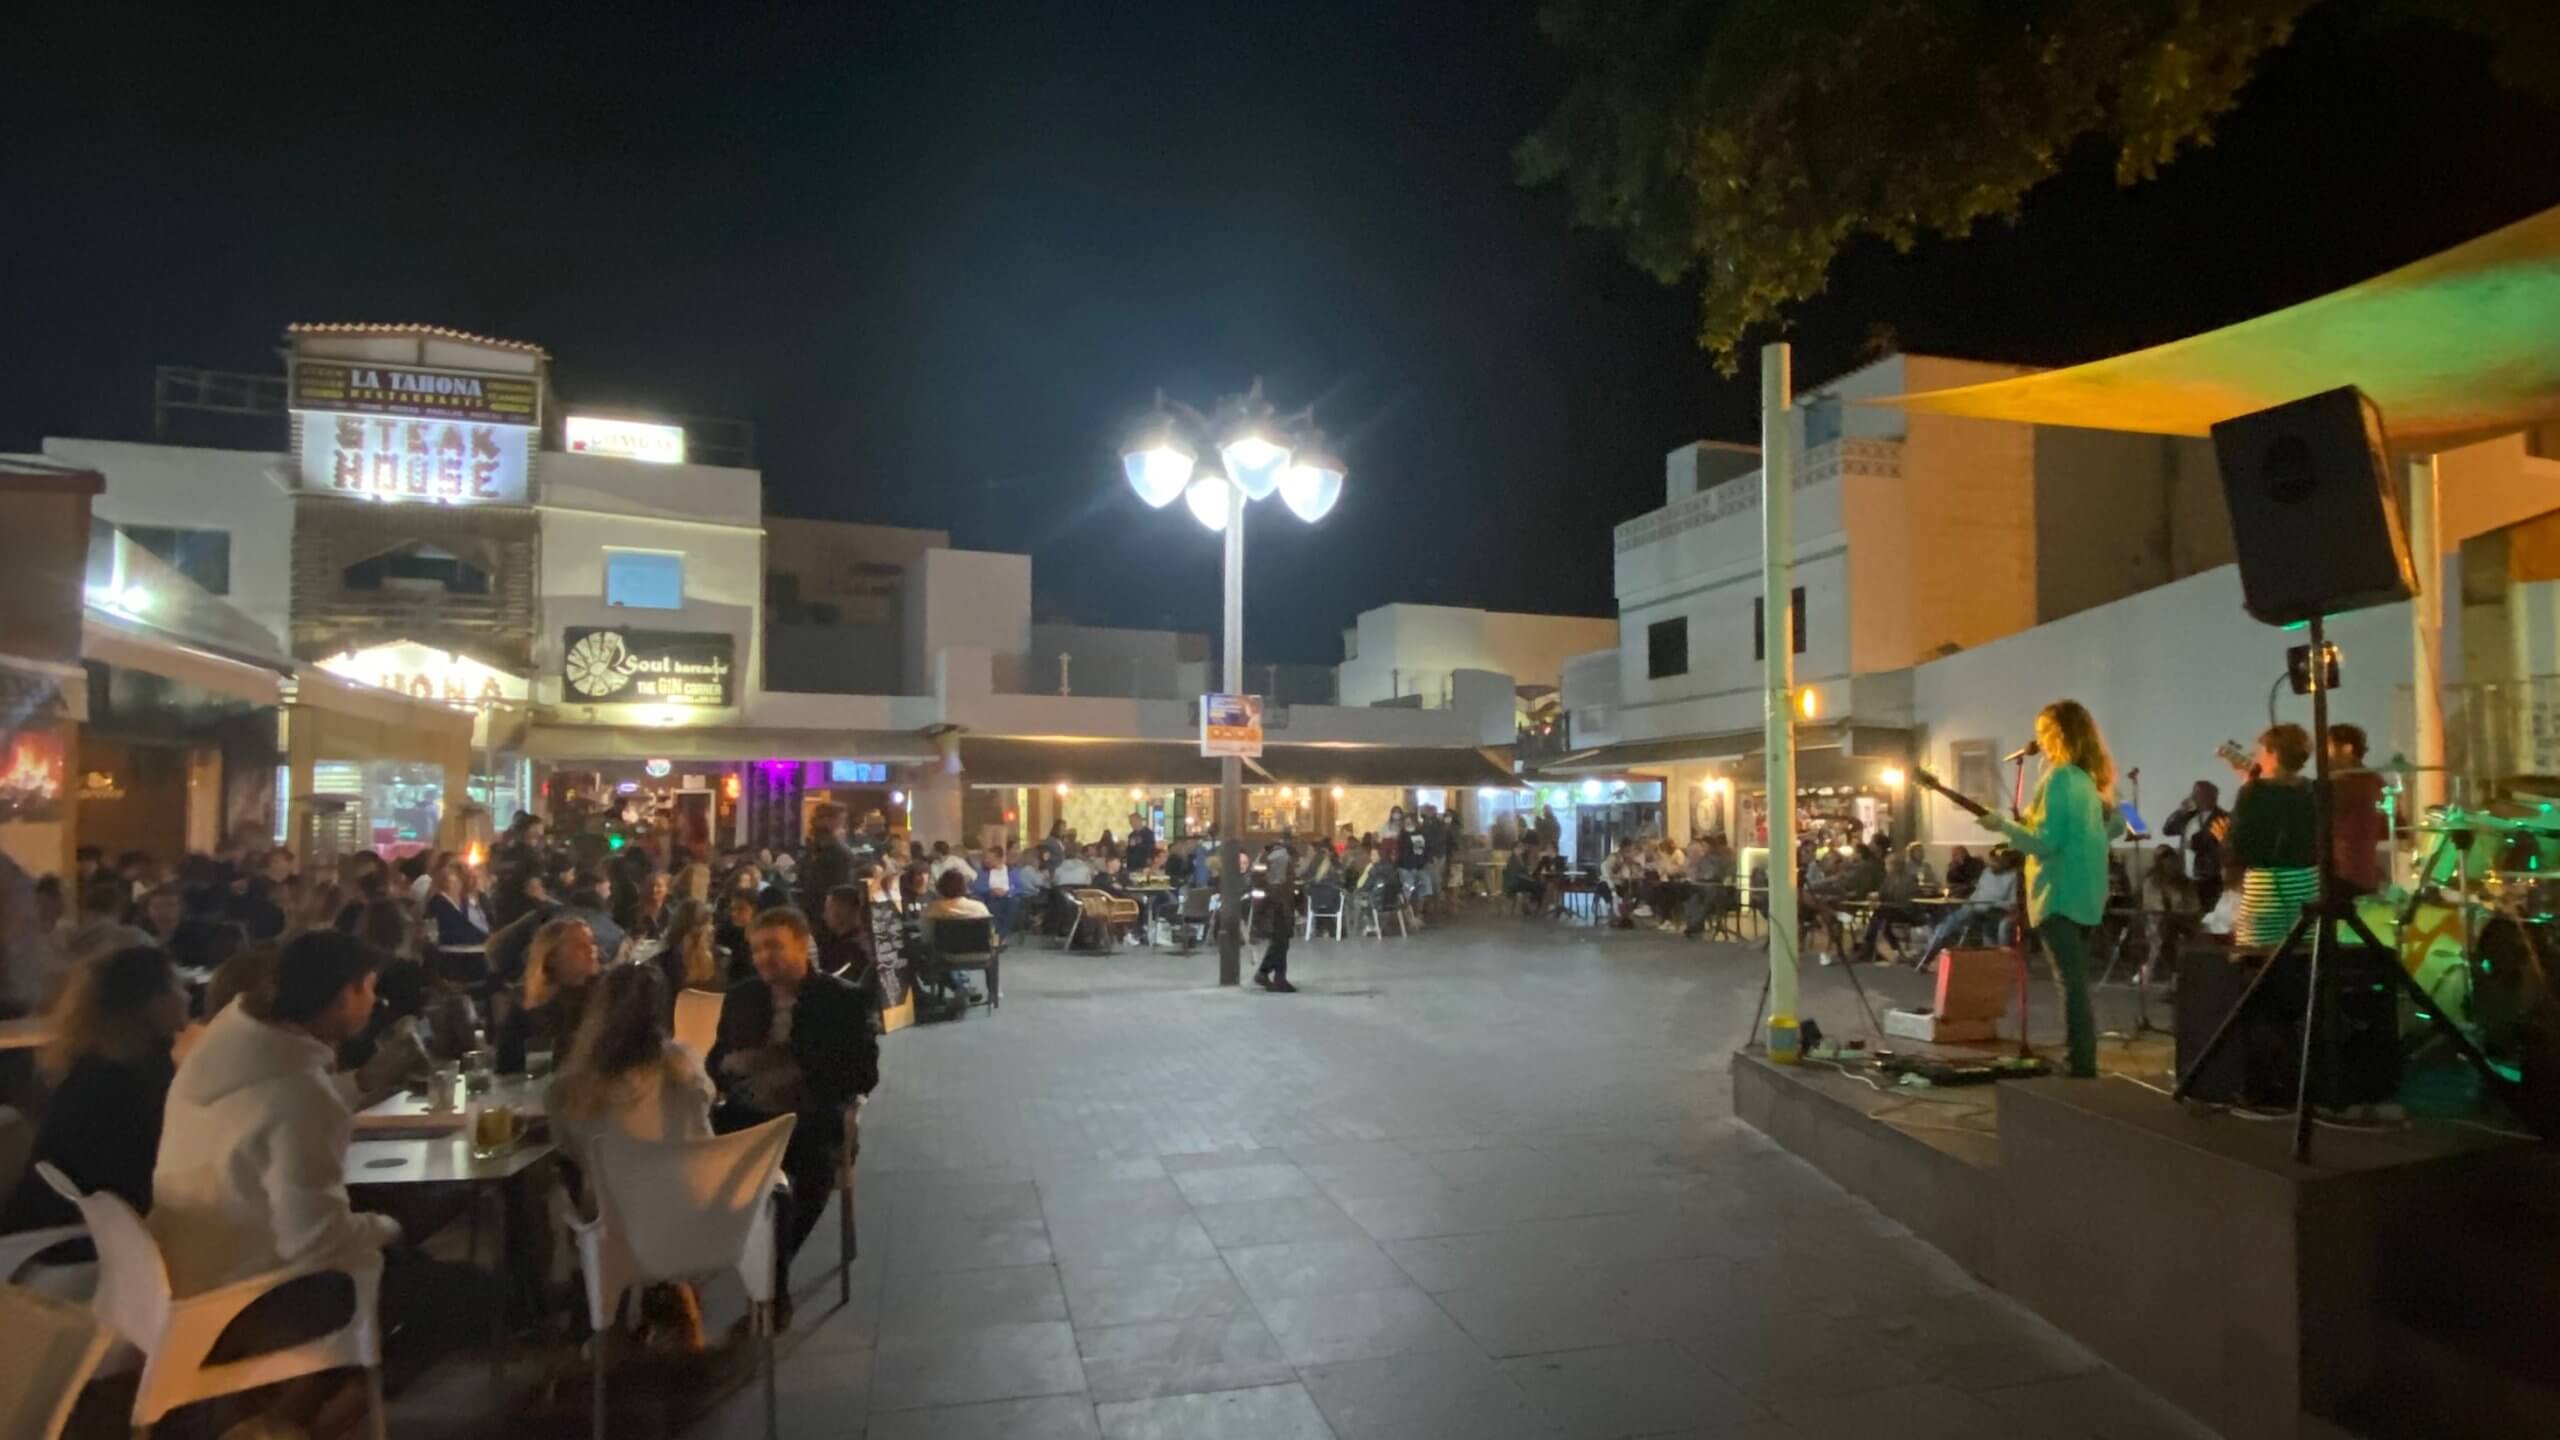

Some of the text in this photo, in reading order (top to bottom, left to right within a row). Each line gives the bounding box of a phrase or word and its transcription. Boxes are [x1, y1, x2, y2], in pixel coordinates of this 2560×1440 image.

[351, 369, 380, 389] LA
[388, 372, 482, 397] TAHONA
[335, 416, 501, 459] STEAK
[333, 449, 500, 498] HOUSE
[618, 655, 671, 675] Soul
[658, 677, 682, 695] GIN
